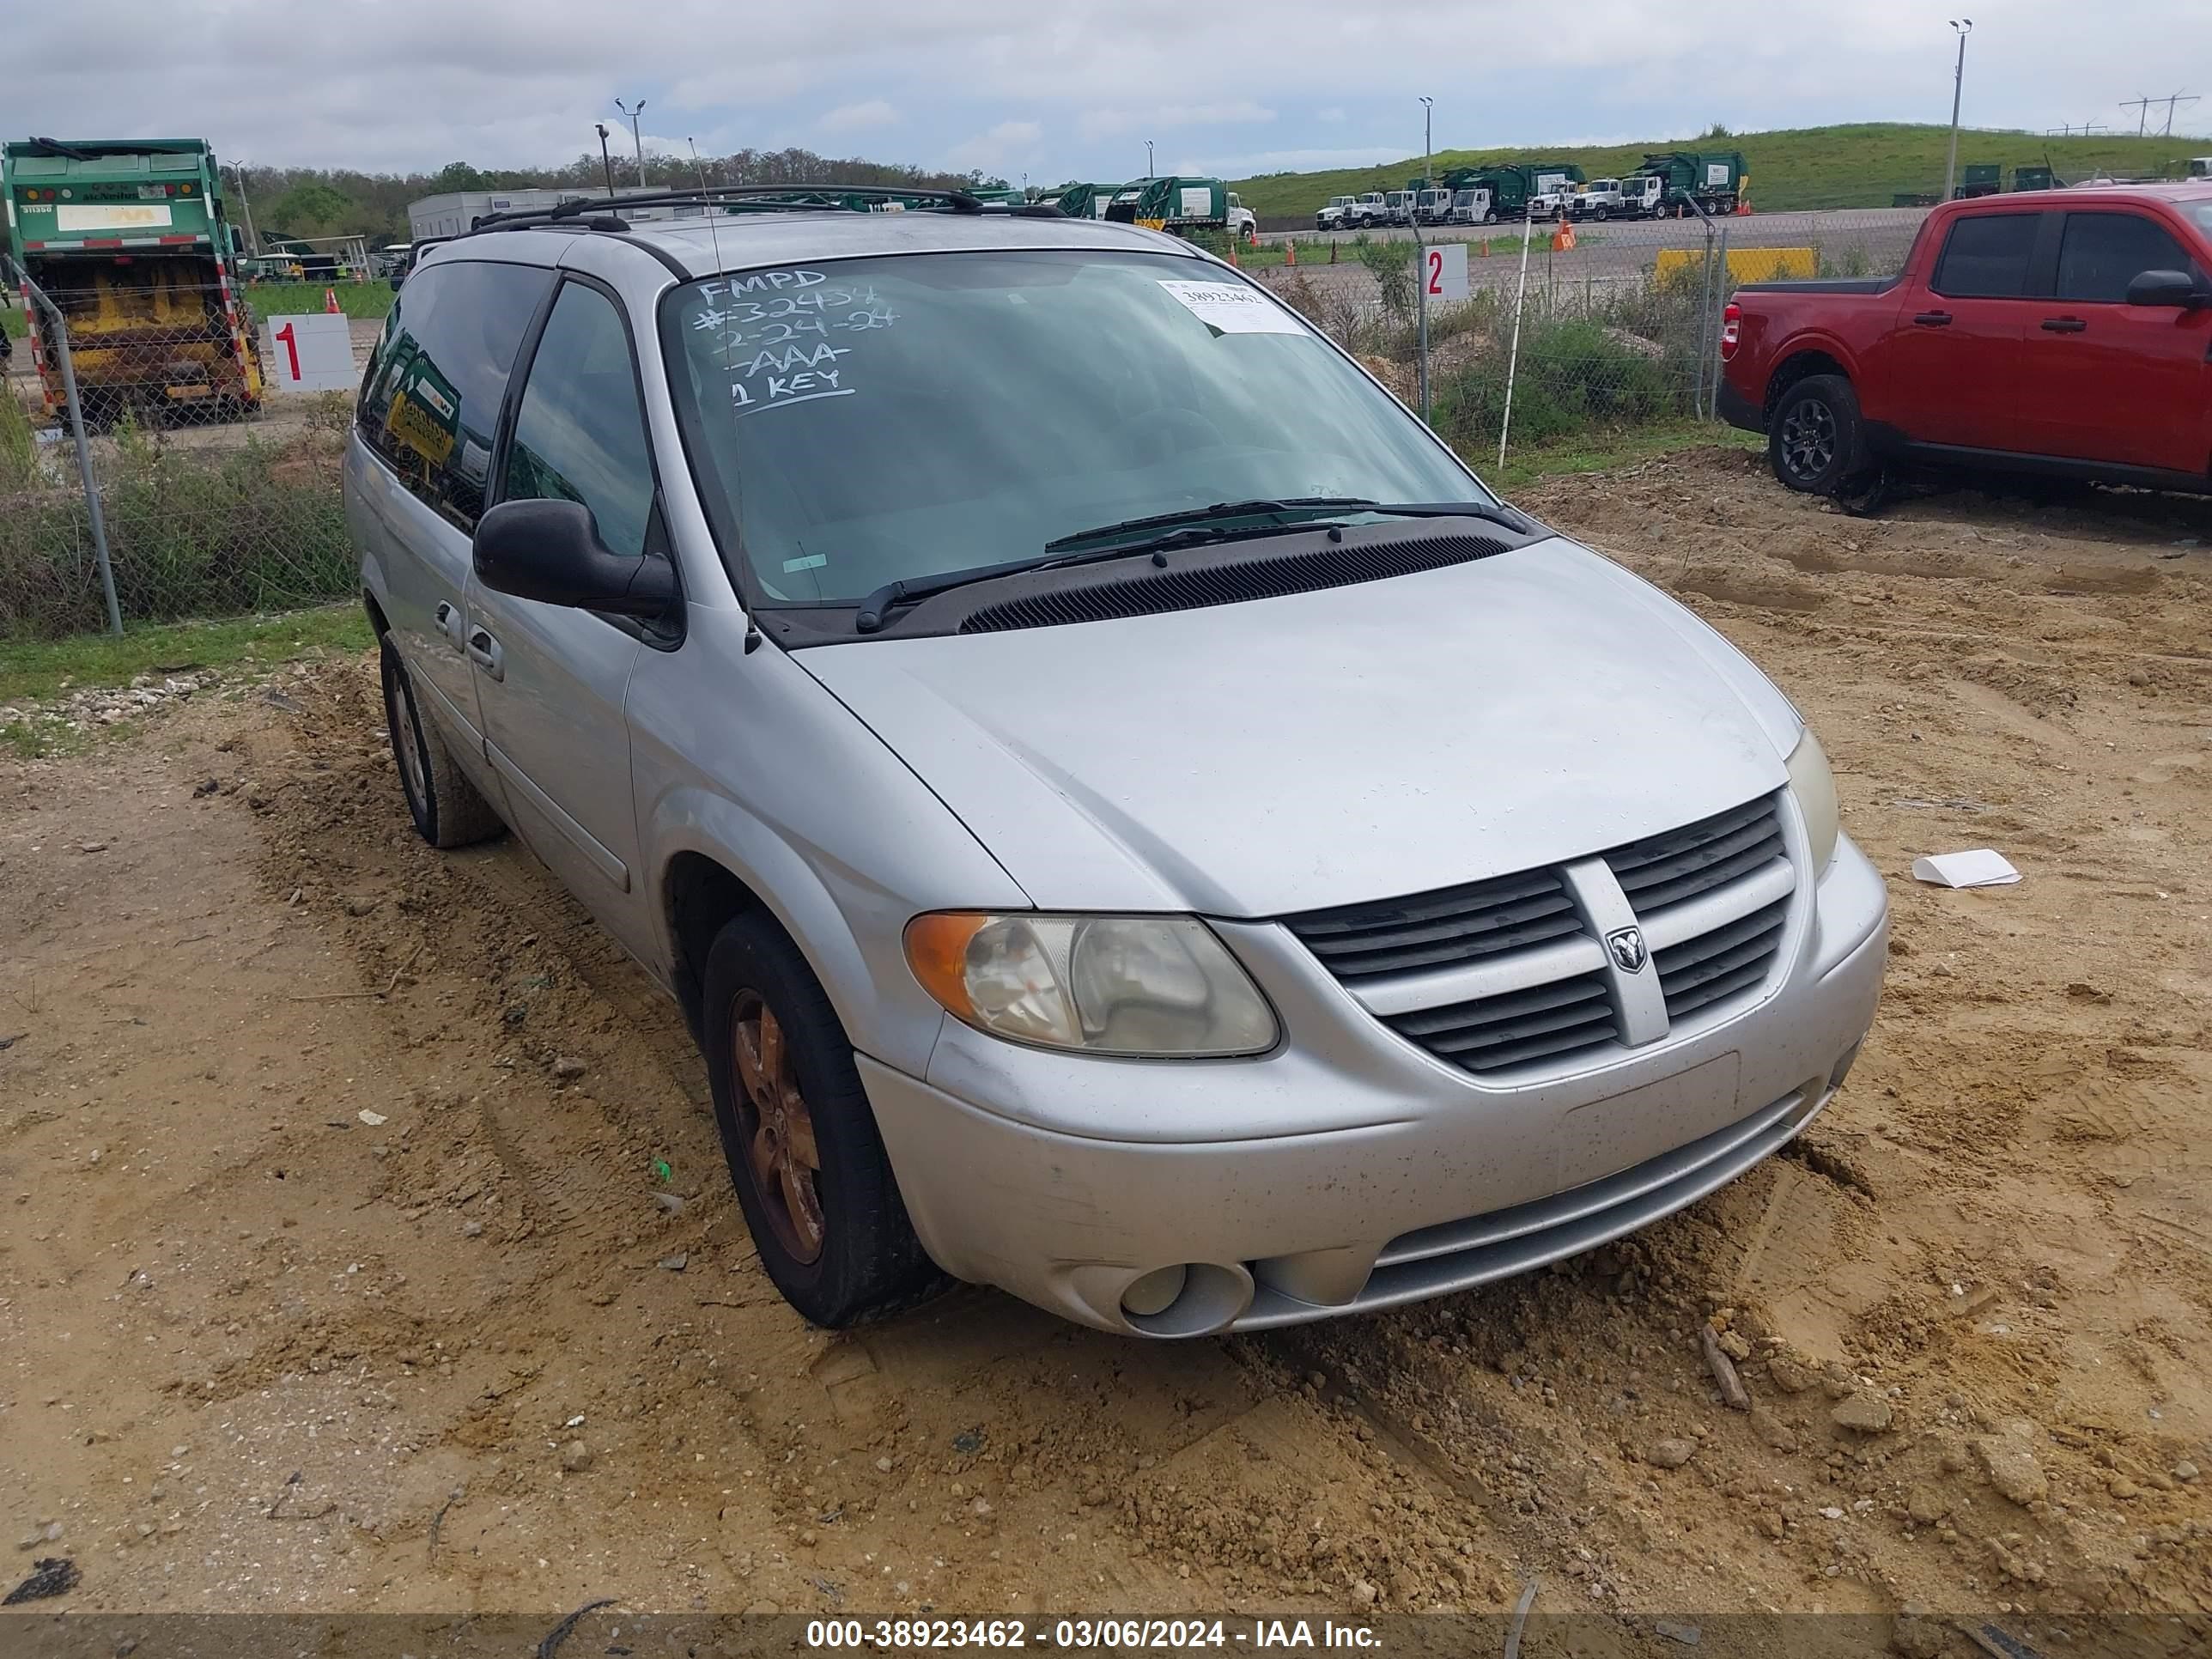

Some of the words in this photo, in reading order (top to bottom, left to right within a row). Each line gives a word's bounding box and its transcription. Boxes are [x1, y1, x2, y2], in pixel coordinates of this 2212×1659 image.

[696, 270, 828, 307] FMPD
[1428, 250, 1443, 295] 2
[1182, 291, 1264, 305] 38923462
[275, 322, 302, 382] 1
[731, 383, 757, 407] 1
[767, 369, 841, 398] KEY
